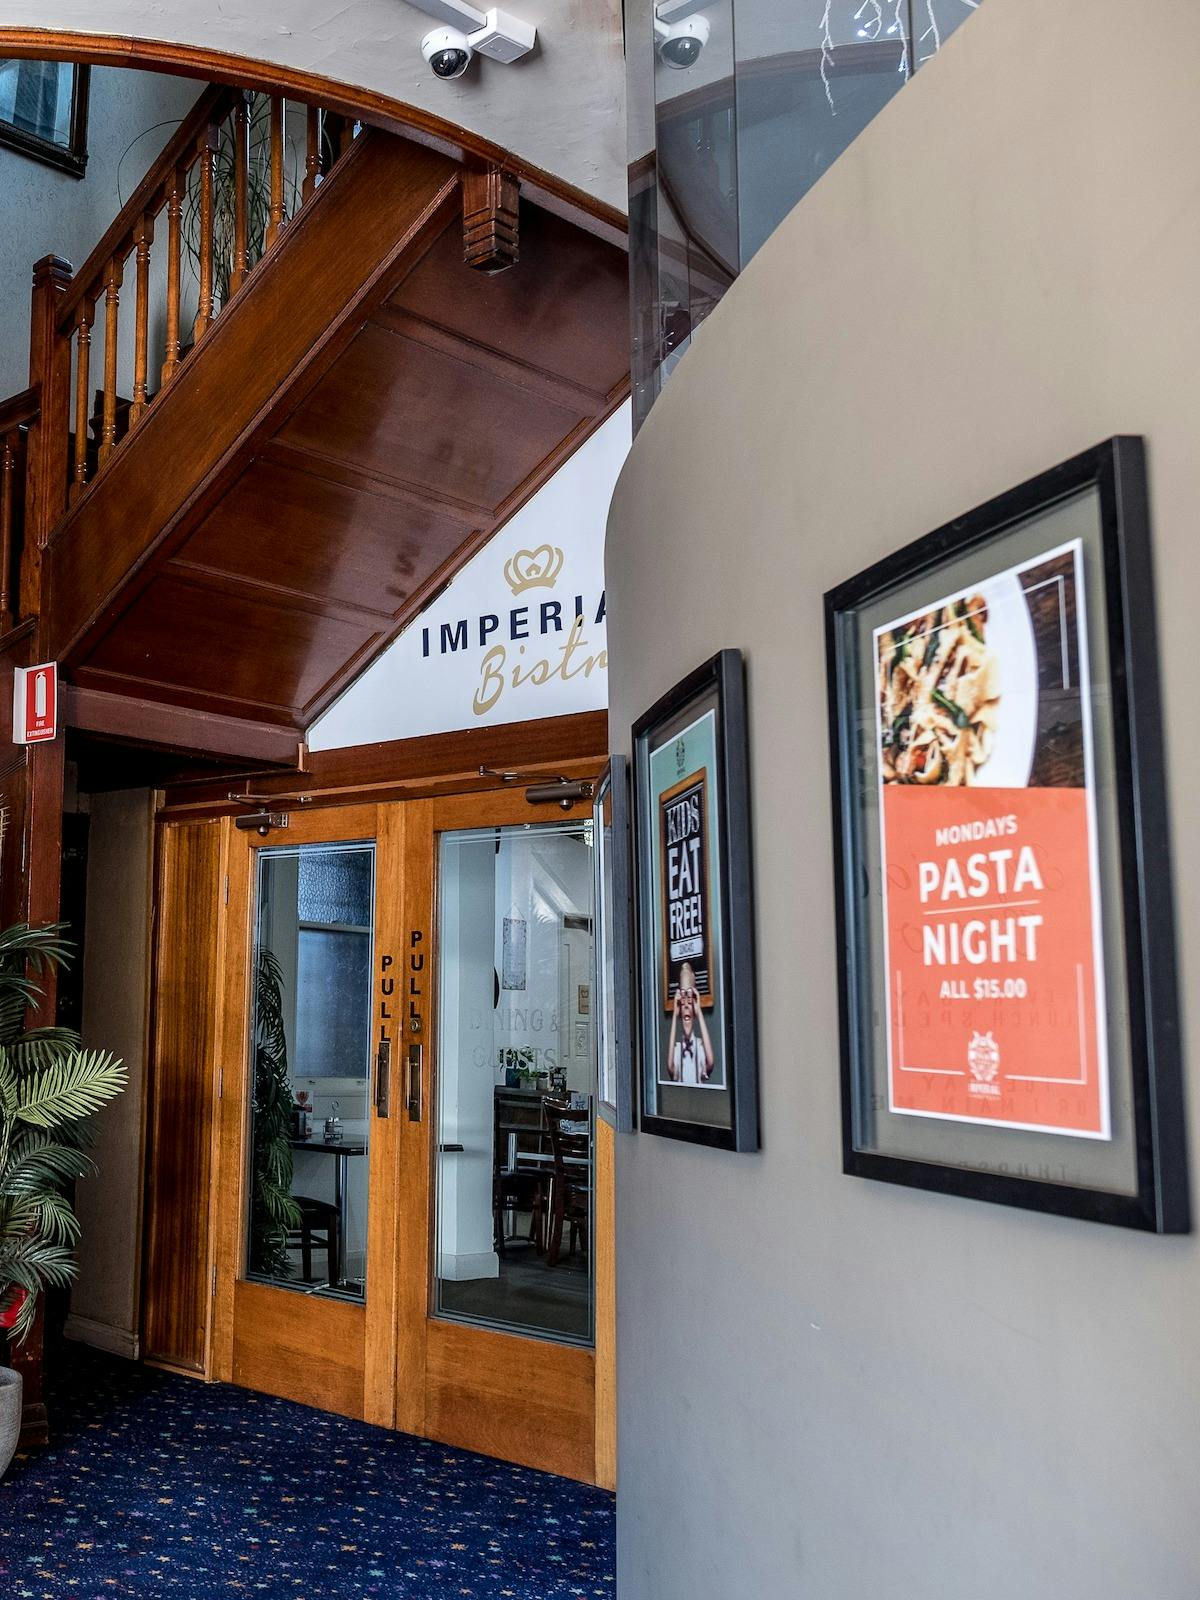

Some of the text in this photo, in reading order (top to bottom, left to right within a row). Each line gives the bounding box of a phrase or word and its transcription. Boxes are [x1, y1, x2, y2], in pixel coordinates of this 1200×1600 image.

[666, 794, 700, 846] KIDS
[935, 814, 1018, 847] MONDAYS
[668, 836, 701, 900] EAT
[918, 846, 1044, 903] PASTA
[669, 894, 703, 940] FREE!
[922, 915, 1044, 967] NIGHT
[380, 955, 394, 1042] PULL
[409, 930, 424, 1019] PULL
[939, 979, 970, 1000] ALL
[974, 977, 1028, 1000] $15.00
